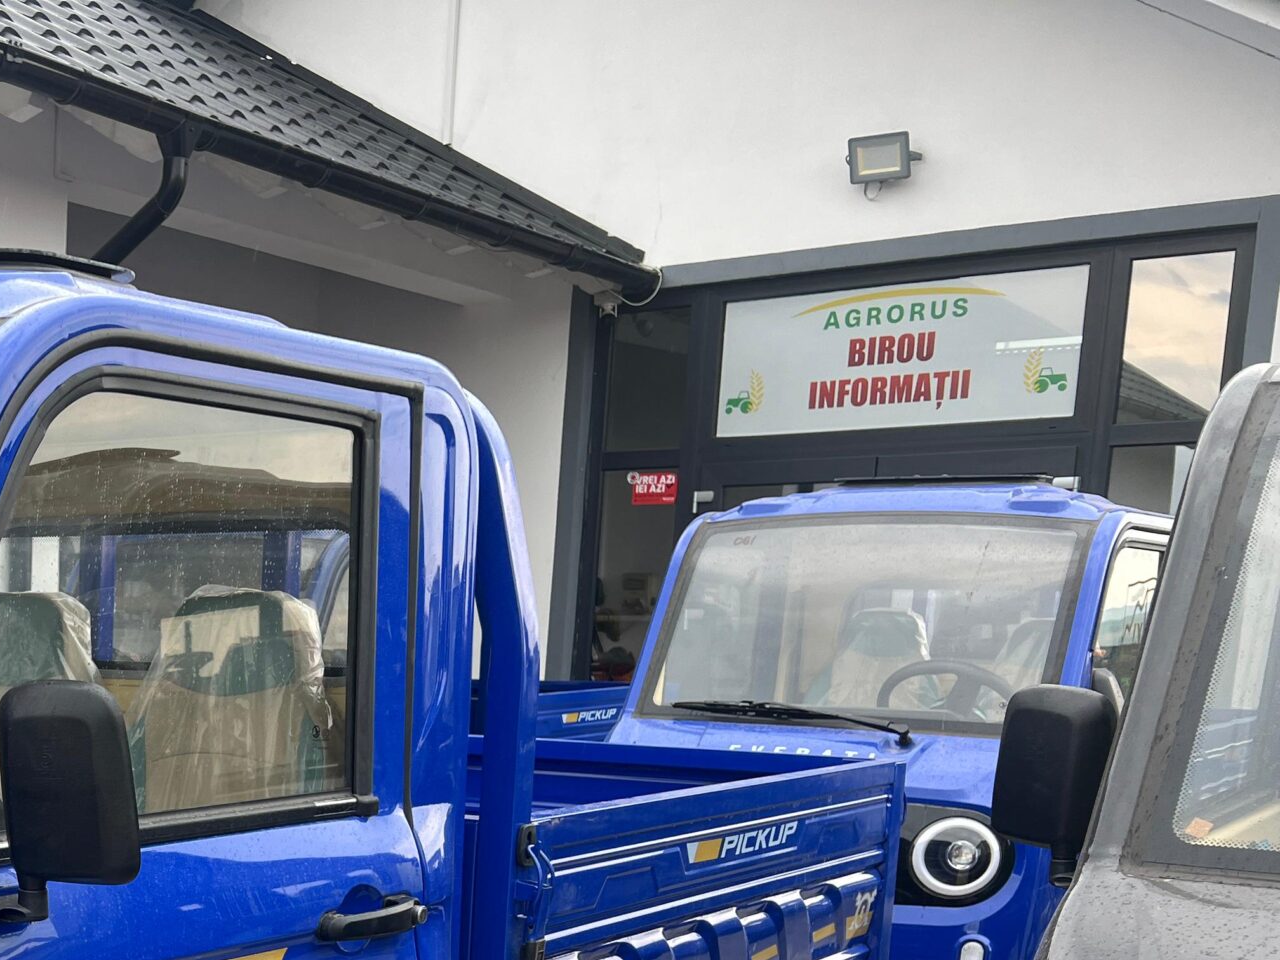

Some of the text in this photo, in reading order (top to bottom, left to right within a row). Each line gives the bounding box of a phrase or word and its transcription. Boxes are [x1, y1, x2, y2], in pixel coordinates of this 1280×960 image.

[823, 297, 969, 331] AGRORUS
[847, 331, 936, 368] BIROU
[808, 369, 972, 410] INFORMAȚII
[578, 707, 618, 722] PICKUP
[720, 820, 798, 858] PICKUP
